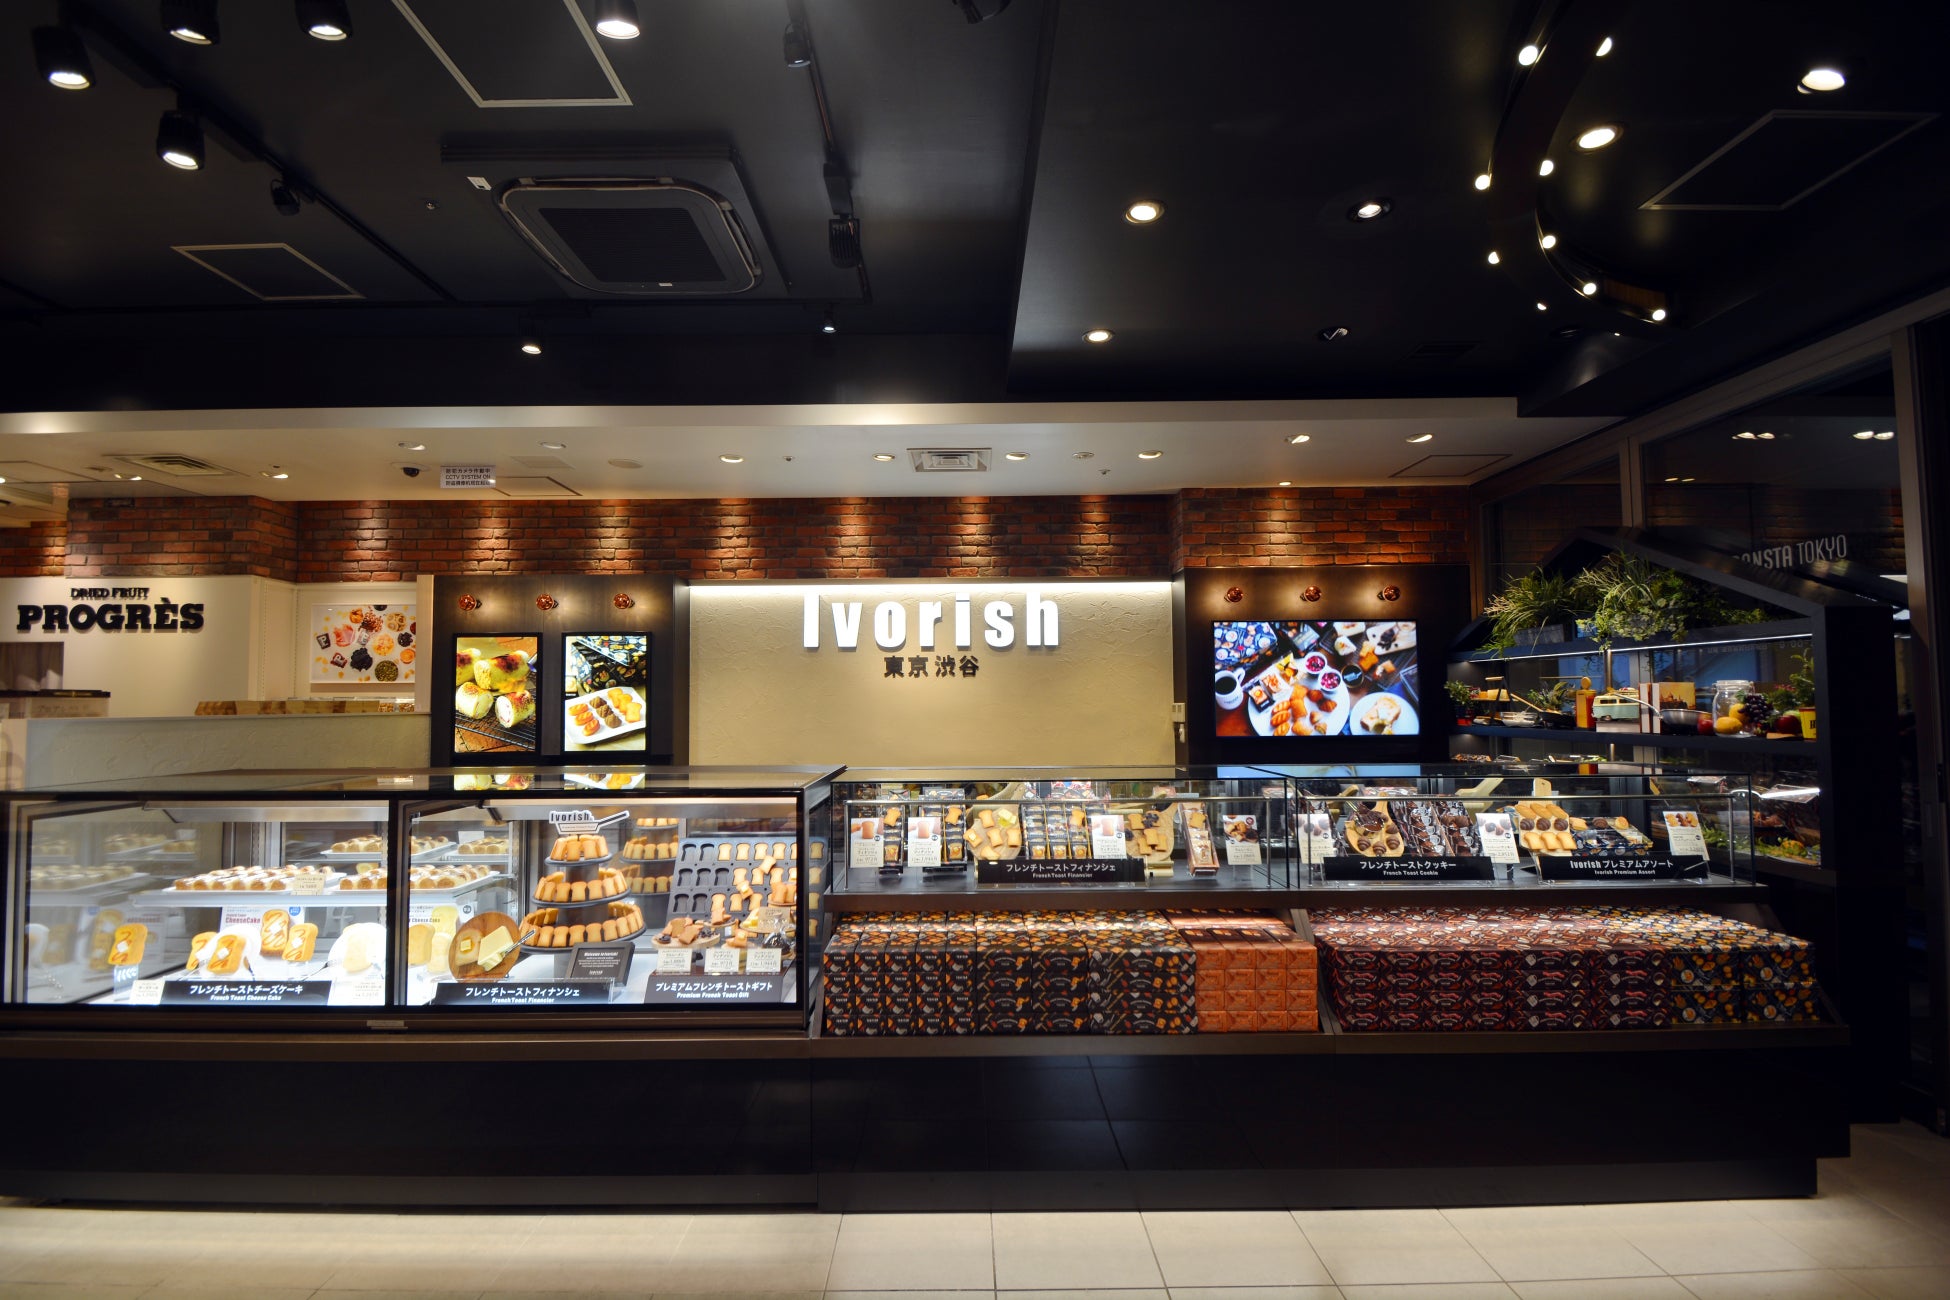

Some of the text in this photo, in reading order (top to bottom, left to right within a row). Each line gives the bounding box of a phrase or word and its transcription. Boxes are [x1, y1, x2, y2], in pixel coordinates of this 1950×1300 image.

[796, 534, 847, 565] TOKYO
[70, 588, 150, 599] DRIED FRUIT
[16, 597, 205, 631] PROGRÈS
[803, 590, 1060, 650] Ivorish
[884, 655, 980, 678] 東京渋谷
[551, 812, 590, 822] Ivorish
[1006, 864, 1116, 872] フレンチトーストフィナンシェ
[1360, 861, 1456, 870] フレンチトーストクッキー
[1570, 860, 1674, 868] Ivorish プレミアムアソート
[190, 985, 303, 994] フレンチトーストチーズケーキ
[656, 982, 772, 991] プレミアムフレンチトーストギフト
[466, 987, 580, 996] フレンチトーストフィナンシェ
